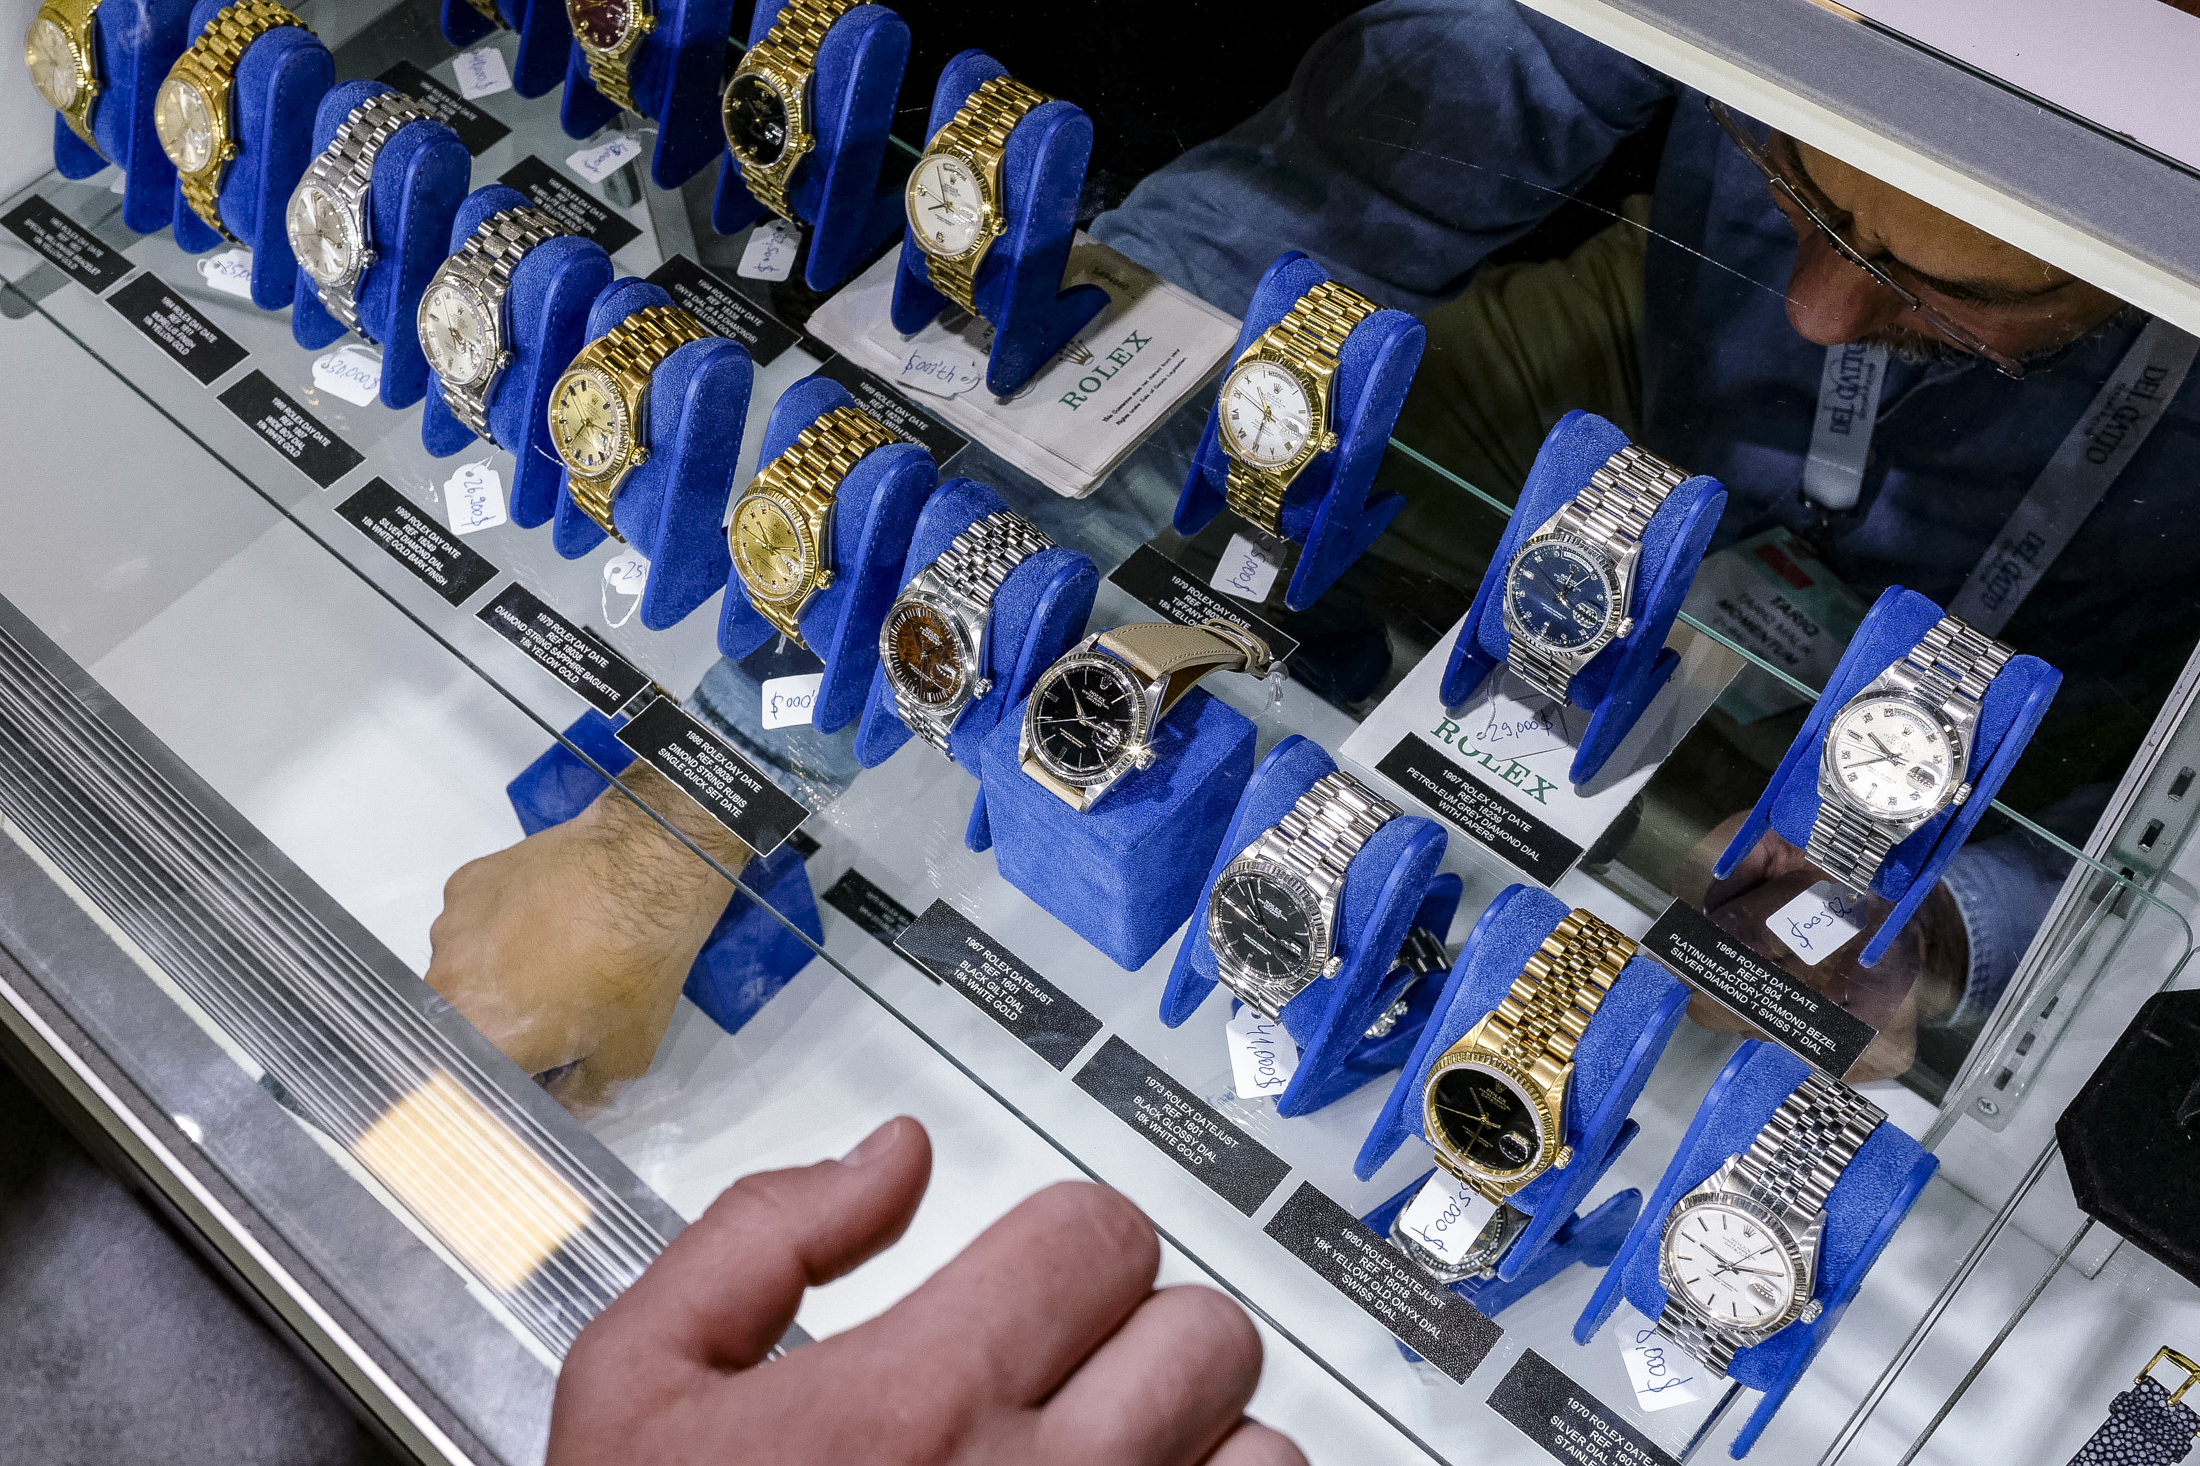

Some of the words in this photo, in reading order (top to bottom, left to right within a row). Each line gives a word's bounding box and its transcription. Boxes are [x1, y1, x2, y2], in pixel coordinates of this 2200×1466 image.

[1058, 329, 1153, 411] ROLEX
[870, 390, 899, 410] ROLEX
[892, 404, 914, 419] DAY
[907, 413, 932, 430] DATE
[369, 523, 395, 543] WHITE
[389, 538, 412, 557] GOLD
[406, 552, 429, 570] BARK
[423, 565, 449, 586] FINISH
[377, 517, 404, 538] SILVER
[398, 533, 432, 560] DIAMOND
[426, 555, 446, 572] DIAL
[400, 523, 420, 539] REF.
[406, 515, 432, 536] ROLEX
[426, 531, 446, 546] DAY
[440, 541, 462, 559] DATE
[1169, 575, 1189, 590] 1979
[1185, 585, 1215, 606] ROLEX
[1210, 602, 1231, 617] DAY
[1227, 613, 1251, 630] DATE
[1169, 596, 1204, 620] TIFFANY
[1182, 594, 1204, 610] REF.
[492, 604, 529, 632] DIAMOND
[523, 627, 554, 651] STRING
[547, 645, 587, 675] SAPPHIRE
[581, 669, 622, 701] BAGUETTE
[529, 644, 561, 669] YELLOW
[556, 665, 581, 684] GOLD
[534, 611, 555, 627] 1979
[549, 622, 577, 644] ROLEX
[571, 639, 592, 655] DAY
[586, 649, 610, 668] DATE
[544, 631, 565, 647] REF.
[770, 689, 820, 720] ,000$
[1487, 708, 1553, 742] 29,000$
[656, 747, 686, 772] SINGLE
[681, 767, 709, 790] QUICK
[703, 785, 724, 802] SET
[718, 797, 743, 818] DATE
[666, 742, 700, 769] DIMOND
[694, 764, 726, 790] STRING
[721, 785, 748, 808] RUBIS
[683, 729, 704, 746] 1986
[699, 741, 728, 765] ROLEX
[723, 760, 744, 778] DAY
[738, 772, 764, 793] DATE
[1429, 716, 1559, 806] ROLEX
[1404, 766, 1459, 805] PETROLEUM
[1454, 800, 1483, 821] GREY
[1479, 816, 1523, 848] DIAMOND
[1518, 843, 1543, 862] DIAL
[1435, 799, 1462, 819] WITH
[1458, 814, 1497, 842] PAPERS
[1440, 768, 1463, 785] 1997
[1459, 780, 1491, 805] ROLEX
[1487, 800, 1509, 817] DAY
[1505, 812, 1532, 833] DATE
[1456, 790, 1479, 808] REF.
[1476, 804, 1503, 824] 18239
[958, 959, 989, 985] BLACK
[984, 979, 1007, 999] GILT
[1003, 993, 1027, 1014] DIAL
[962, 935, 985, 953] 1967
[980, 948, 1013, 975] ROLEX
[1008, 969, 1054, 1007] DATEJUST
[979, 961, 1002, 980] REF.
[998, 976, 1021, 994] 1601
[1667, 932, 1718, 970] PLATINUM
[1713, 963, 1763, 1001] FACTORY
[1759, 994, 1808, 1031] DIAMOND
[1805, 1024, 1840, 1052] BEZEL
[1713, 939, 1738, 959] 1966
[1735, 954, 1771, 981] ROLEX
[1768, 976, 1792, 995] DAY
[1789, 990, 1819, 1013] DATE
[1735, 966, 1760, 986] REF.
[1758, 982, 1783, 1001] 1804
[965, 978, 995, 1003] WHITE
[991, 998, 1019, 1022] GOLD
[1667, 946, 1705, 975] SILVER
[1701, 968, 1750, 1005] DIAMOND
[1756, 1005, 1792, 1033] SWISS
[1798, 1033, 1826, 1055] DIAL
[1131, 1094, 1164, 1121] BLACK
[1160, 1115, 1200, 1148] GLOSSY
[1195, 1142, 1219, 1163] DIAL
[1142, 1074, 1166, 1094] 1973
[1162, 1089, 1195, 1117] ROLEX
[1191, 1111, 1239, 1149] DATEJUST
[1161, 1102, 1185, 1122] REF.
[1181, 1117, 1204, 1137] 1601
[1146, 1120, 1179, 1147] WHITE
[1174, 1141, 1204, 1166] GOLD
[1328, 1249, 1372, 1285] YELLOW
[1368, 1279, 1393, 1300] OLD
[1389, 1295, 1422, 1323] ONYX
[1417, 1316, 1444, 1340] DIAL
[1339, 1226, 1364, 1248] 1980
[1360, 1242, 1397, 1273] ROLEX
[1393, 1268, 1446, 1311] DATEJUST
[1357, 1255, 1383, 1278] REF.
[1380, 1273, 1411, 1299] 16018
[1373, 1298, 1400, 1322] DIAL
[1548, 1414, 1588, 1447] SILVER
[1584, 1441, 1612, 1466] DIAL
[1565, 1396, 1591, 1419] 1970
[1587, 1413, 1625, 1446] ROLEX
[1587, 1429, 1614, 1453] REF.
